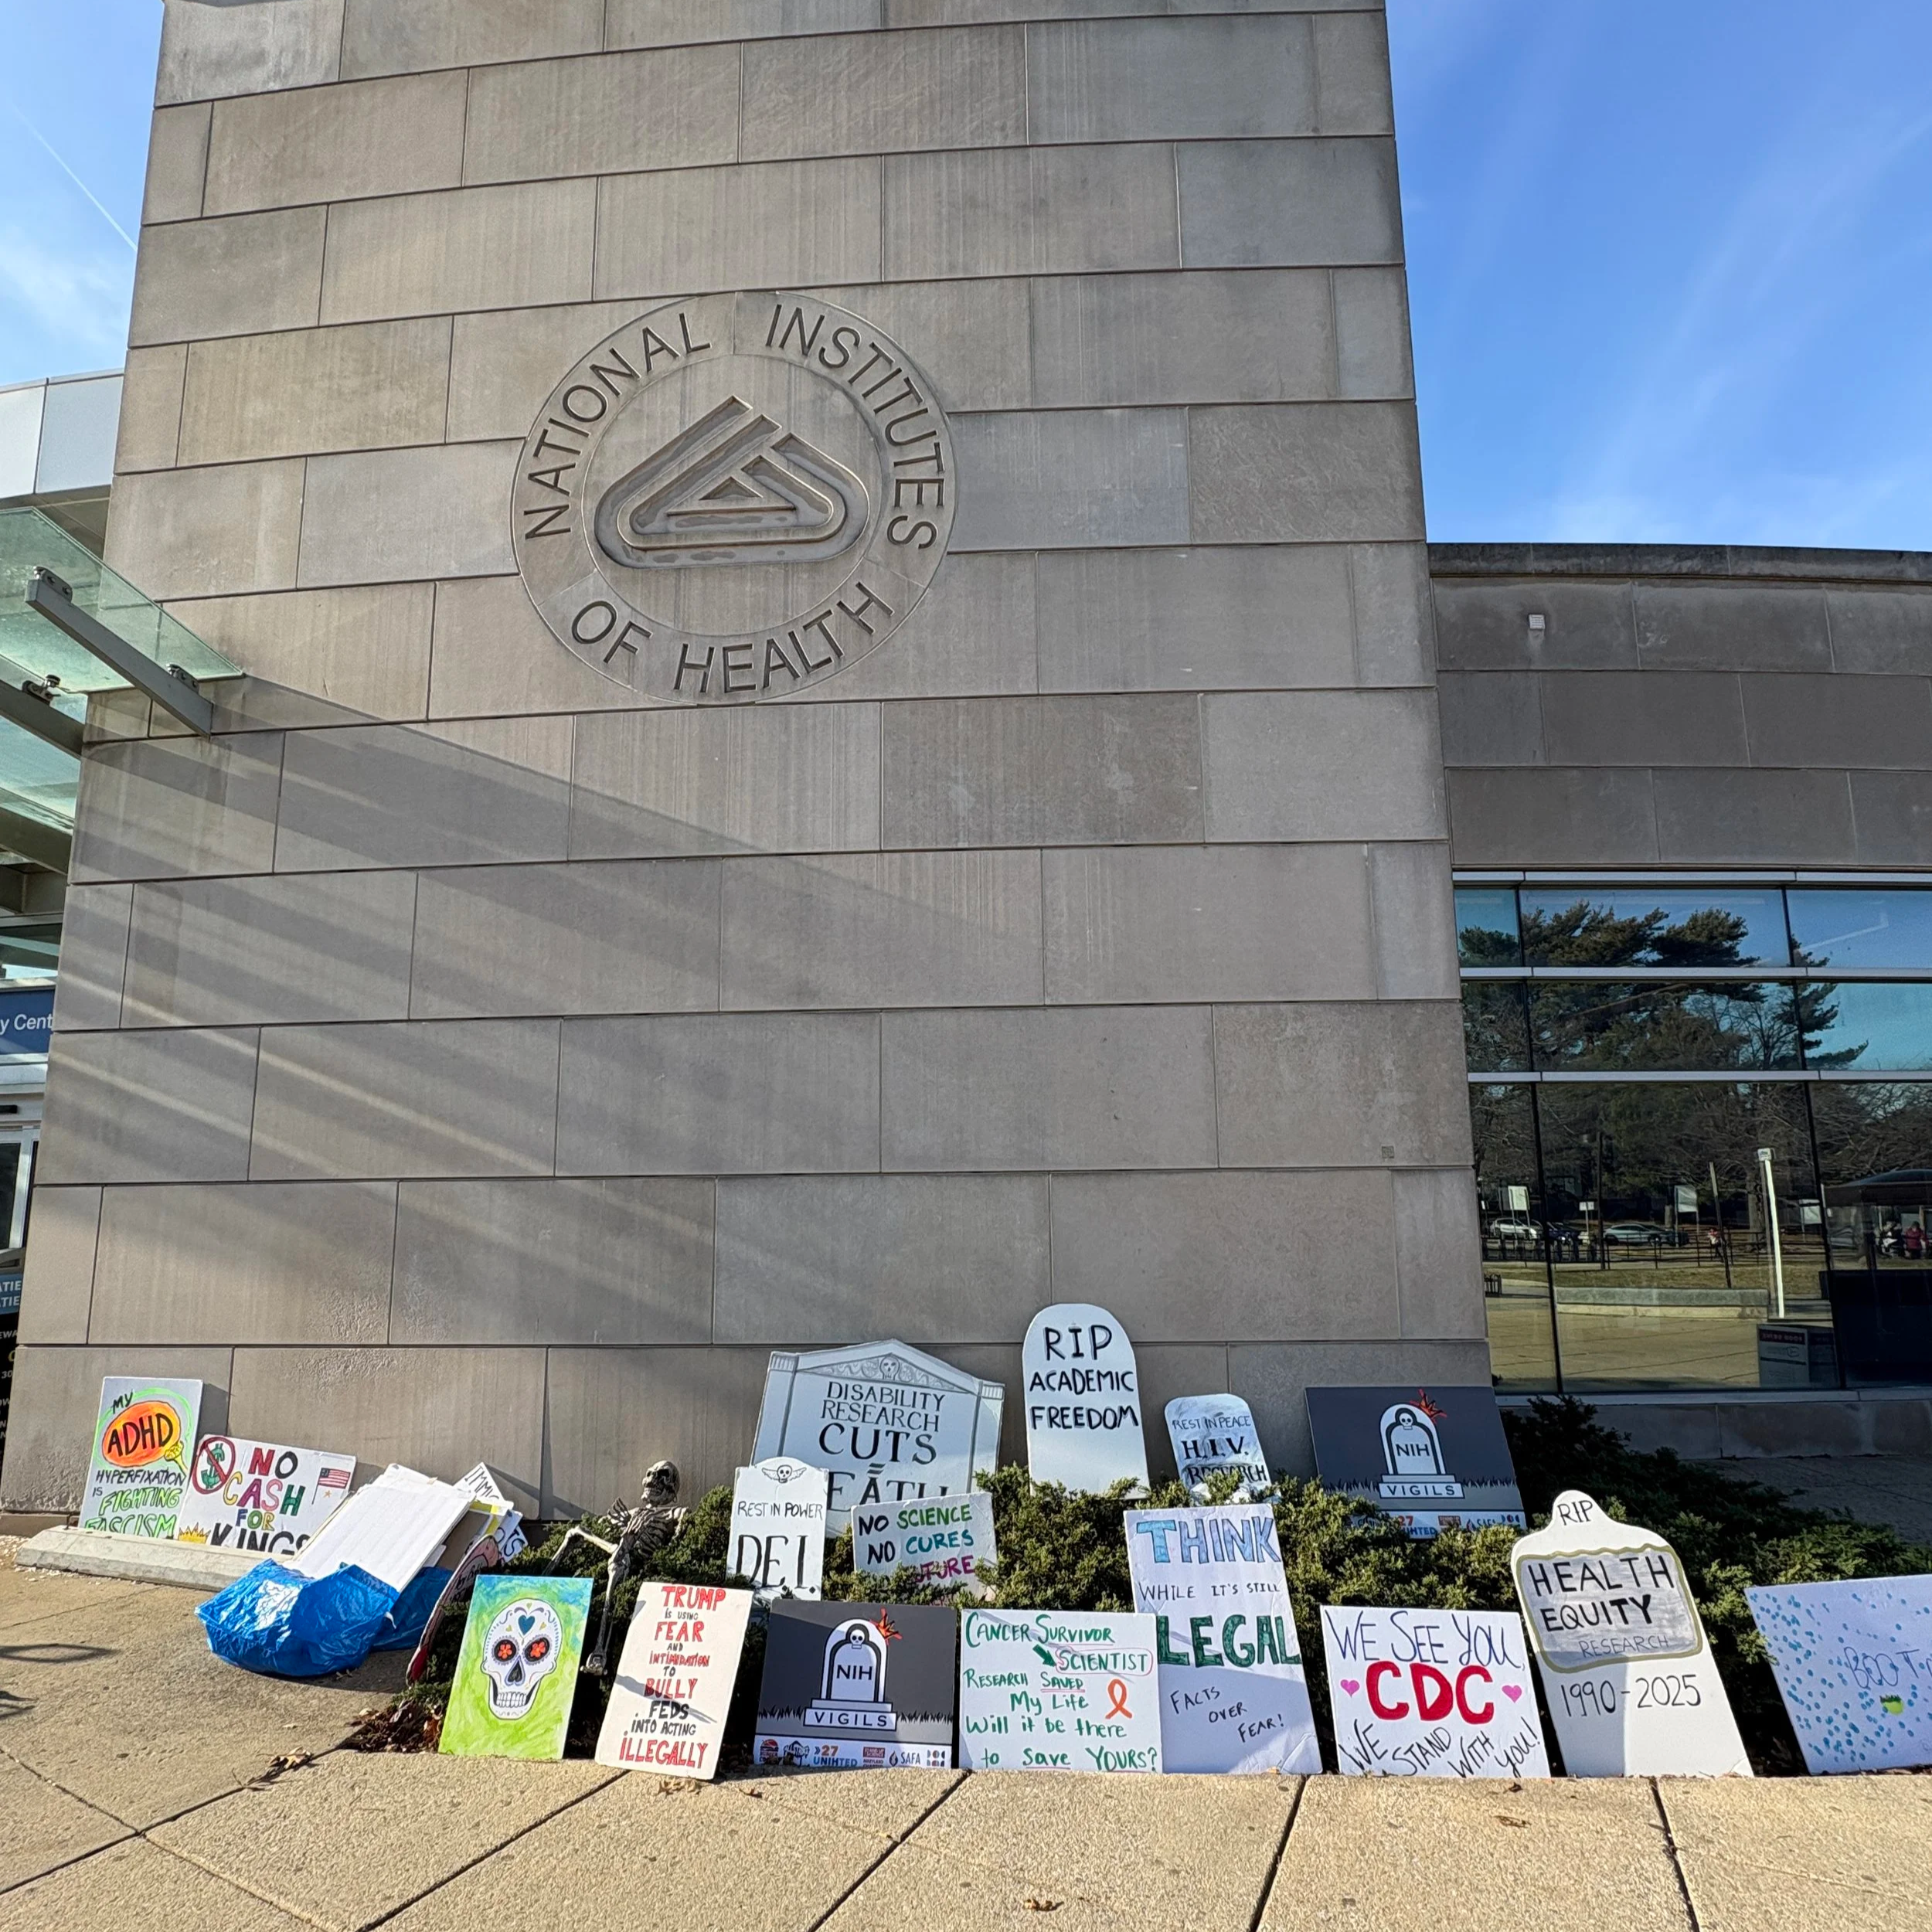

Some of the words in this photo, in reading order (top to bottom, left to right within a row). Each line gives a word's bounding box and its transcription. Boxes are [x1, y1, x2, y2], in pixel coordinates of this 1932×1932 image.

[524, 313, 712, 539] NATIONAL
[765, 304, 945, 549] INSTITUTES
[571, 600, 651, 664] OF
[673, 581, 895, 693] HEALTH
[1044, 1325, 1113, 1361] RIP
[1029, 1368, 1134, 1395] ACADEMIC
[111, 1389, 134, 1414] MY
[826, 1381, 946, 1412] DISABILITY
[820, 1400, 940, 1432] RESEARCH
[1030, 1405, 1140, 1430] FREEDOM
[1172, 1419, 1202, 1430] REST
[1204, 1417, 1217, 1429] IN
[1219, 1415, 1252, 1429] PEACE
[107, 1413, 174, 1458] ADHD
[818, 1422, 937, 1465] CUTS
[1181, 1436, 1250, 1460] H.I.V.
[248, 1447, 298, 1479] NO
[1395, 1444, 1430, 1457] NIH
[96, 1468, 186, 1486] HYPERFIXATION
[92, 1486, 104, 1498] IS
[98, 1486, 183, 1516] FIGHTING
[223, 1471, 306, 1516] CASH
[1386, 1485, 1455, 1495] VIGILS
[236, 1509, 274, 1531] FOR
[737, 1501, 768, 1517] REST
[770, 1502, 781, 1516] IN
[784, 1502, 823, 1521] POWER
[858, 1515, 889, 1537] NO
[896, 1504, 974, 1529] SCIENCE
[1557, 1499, 1593, 1526] RIP
[867, 1541, 896, 1566] NO
[906, 1529, 974, 1556] CURES
[1137, 1516, 1282, 1564] THINK
[1528, 1555, 1675, 1597] HEALTH
[661, 1586, 726, 1611] TRUMP
[1138, 1582, 1196, 1601] WHILE
[1211, 1583, 1239, 1597] IT'S
[1247, 1582, 1281, 1593] STILL
[677, 1611, 699, 1621] USING
[1540, 1594, 1652, 1631] EQUITY
[654, 1621, 705, 1642] FEAR
[966, 1611, 1032, 1648] CANCER
[1036, 1614, 1116, 1643] SURVIVOR
[1156, 1614, 1302, 1668] LEGAL
[1325, 1610, 1379, 1662] WE
[1390, 1611, 1449, 1664] SEE
[667, 1642, 683, 1651] AND
[1579, 1634, 1669, 1658] RESEARCH
[663, 1666, 675, 1677] TO
[836, 1665, 872, 1680] NIH
[1059, 1650, 1148, 1672] SCIENTIST
[645, 1678, 699, 1699] BULLY
[964, 1668, 1028, 1689] RESEARCH
[1040, 1671, 1085, 1689] SAVED
[1010, 1691, 1043, 1716] My
[1052, 1694, 1090, 1711] Life
[1169, 1686, 1220, 1715] FACTS
[1366, 1661, 1495, 1725] CDC
[649, 1700, 689, 1719] FEDS
[814, 1712, 887, 1727] VIGILS
[1208, 1702, 1247, 1723] OVER
[660, 1721, 696, 1736] ACTING
[966, 1714, 1009, 1734] Will
[1022, 1716, 1036, 1732] it
[1046, 1717, 1066, 1733] be
[1074, 1718, 1128, 1738] there
[1238, 1713, 1285, 1743] FEAR!
[821, 1744, 838, 1757] 27
[900, 1751, 920, 1765] SAFA
[981, 1747, 999, 1768] to
[1085, 1745, 1158, 1772] YOURS?
[1338, 1719, 1388, 1770] WE
[1389, 1726, 1452, 1777] STAND
[1447, 1730, 1495, 1777] WITH
[813, 1757, 858, 1767] UNIHTED
